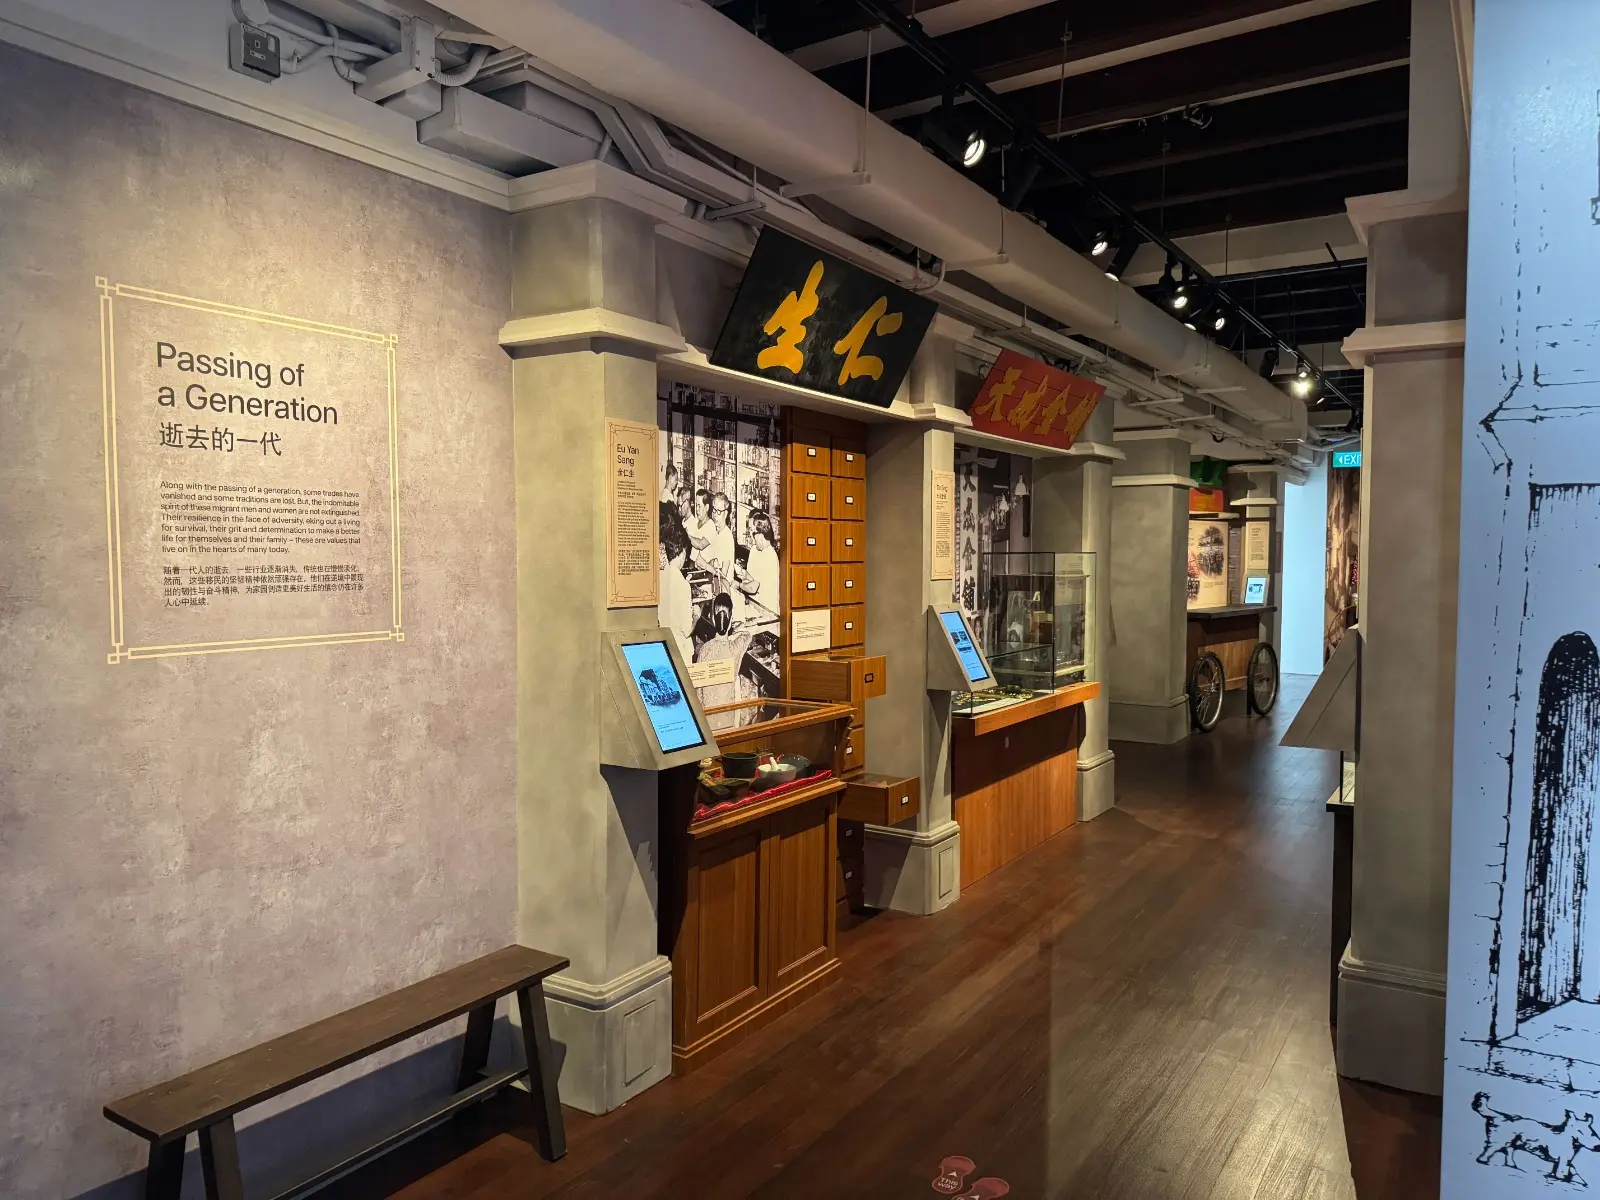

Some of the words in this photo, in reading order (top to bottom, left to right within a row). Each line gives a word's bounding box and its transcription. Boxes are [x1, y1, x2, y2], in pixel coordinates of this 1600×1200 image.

[156, 341, 272, 389] Passing
[279, 363, 305, 387] of
[157, 385, 175, 407] a
[185, 383, 338, 425] Generation
[159, 421, 282, 457] 逝去的一代
[617, 443, 626, 453] Eu
[627, 445, 640, 455] Yan
[617, 454, 635, 467] Sang
[1343, 453, 1362, 465] EXI
[160, 480, 184, 490] Along
[186, 482, 202, 490] with
[204, 483, 216, 491] the
[218, 484, 247, 493] passing
[264, 487, 302, 496] generation,
[160, 492, 196, 500] vanished
[236, 495, 269, 503] traditions
[297, 498, 310, 506] But,
[323, 499, 360, 507] indomitable
[160, 503, 180, 512] spirit
[212, 505, 240, 513] migrant
[184, 514, 221, 522] resilience
[272, 517, 305, 525] adversity,
[306, 518, 324, 526] eking
[343, 519, 360, 527] living
[161, 524, 173, 532] for
[174, 524, 208, 533] survival,
[228, 526, 241, 534] grit
[259, 526, 306, 534] determination
[266, 536, 288, 544] family
[247, 546, 267, 554] many
[269, 546, 290, 554] today.
